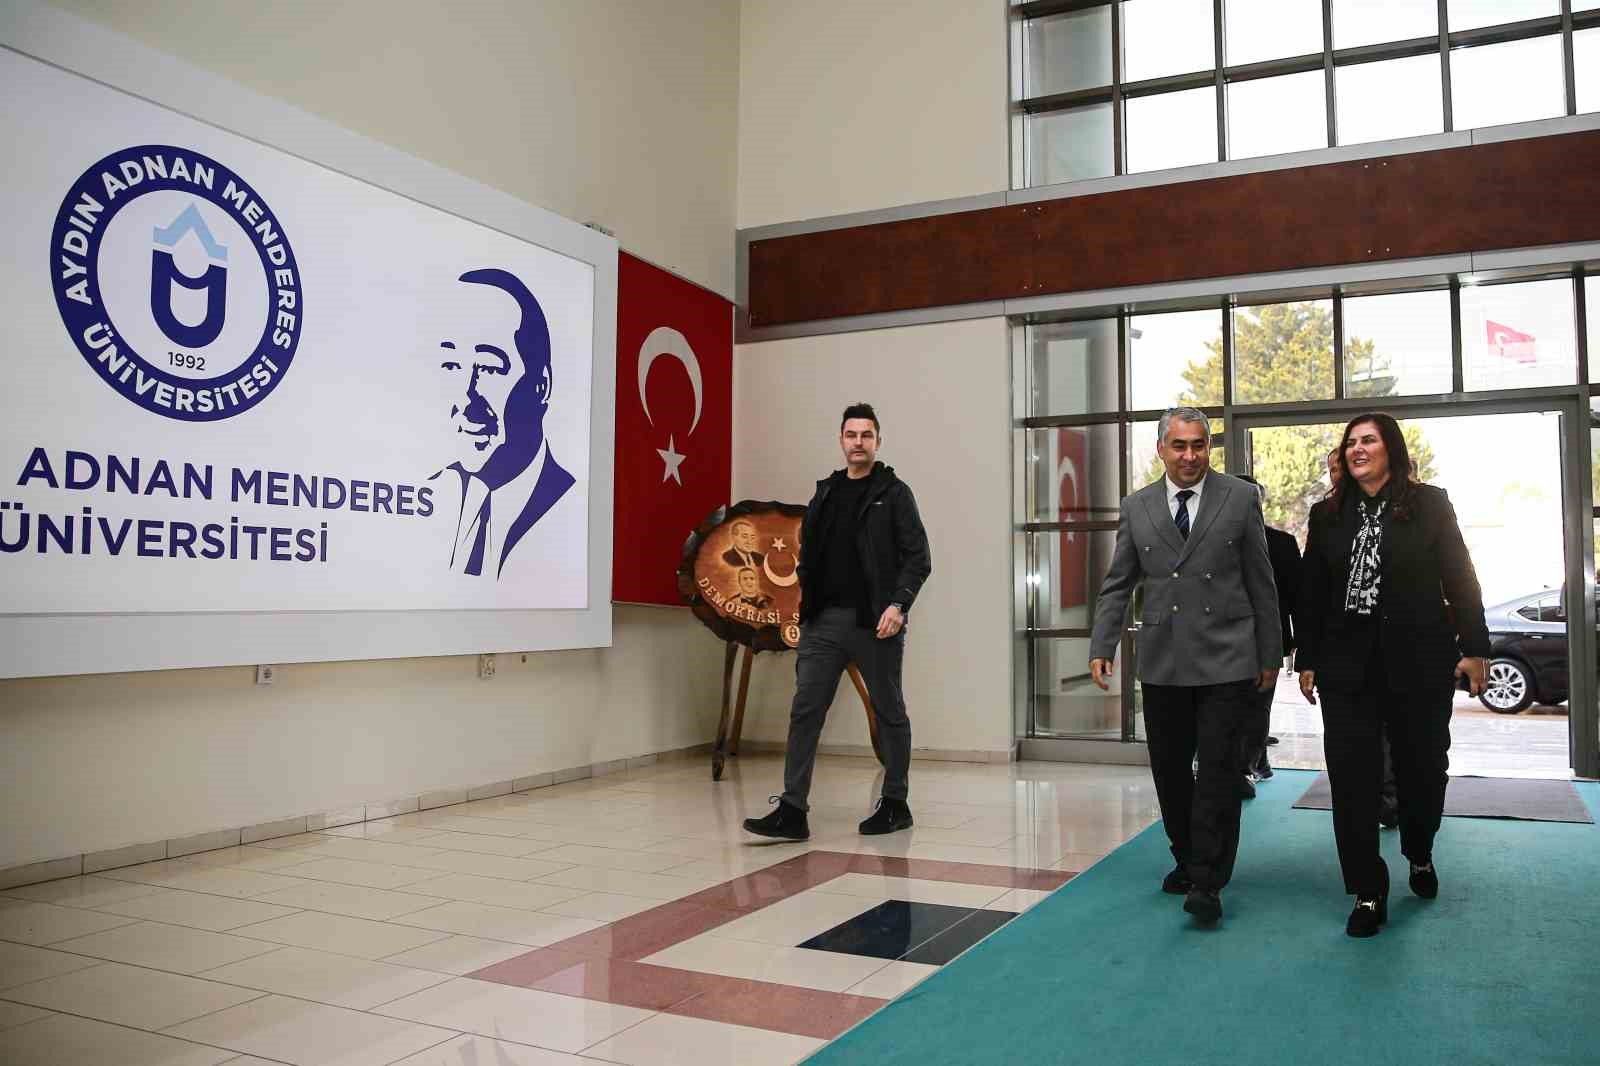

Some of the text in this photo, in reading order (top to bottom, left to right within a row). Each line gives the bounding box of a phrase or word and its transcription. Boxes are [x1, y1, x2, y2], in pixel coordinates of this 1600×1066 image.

[62, 155, 296, 350] AYDIN ADNAN MENDERES
[83, 322, 279, 413] ÜNİVERSİTESİ
[168, 352, 206, 371] 1992
[17, 447, 434, 517] ADNAN MENDERES
[0, 502, 327, 562] ÜNİVERSİTESİ
